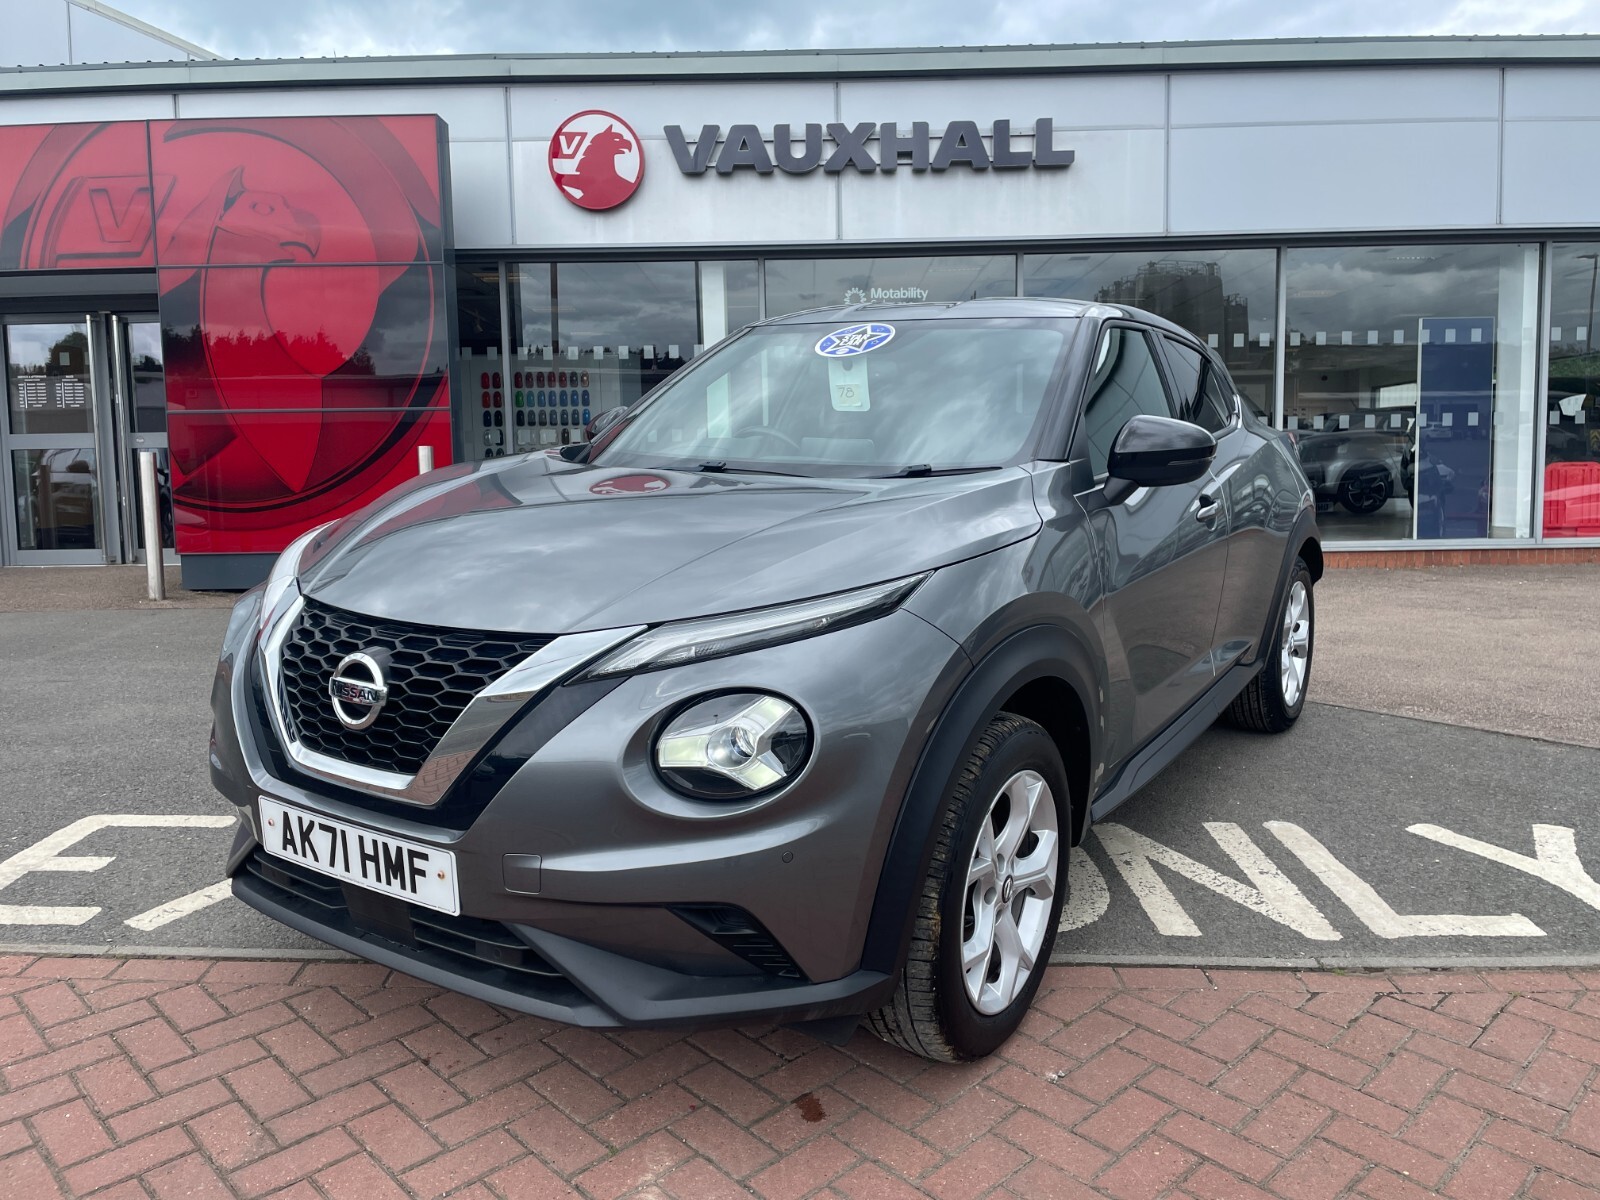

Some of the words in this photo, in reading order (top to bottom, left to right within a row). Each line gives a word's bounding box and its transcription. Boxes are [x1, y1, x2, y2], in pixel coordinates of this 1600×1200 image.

[663, 118, 1076, 175] VAUXHALL
[870, 287, 929, 301] Motability
[837, 387, 855, 398] 78
[282, 811, 351, 873] AK71
[358, 834, 429, 894] HMF
